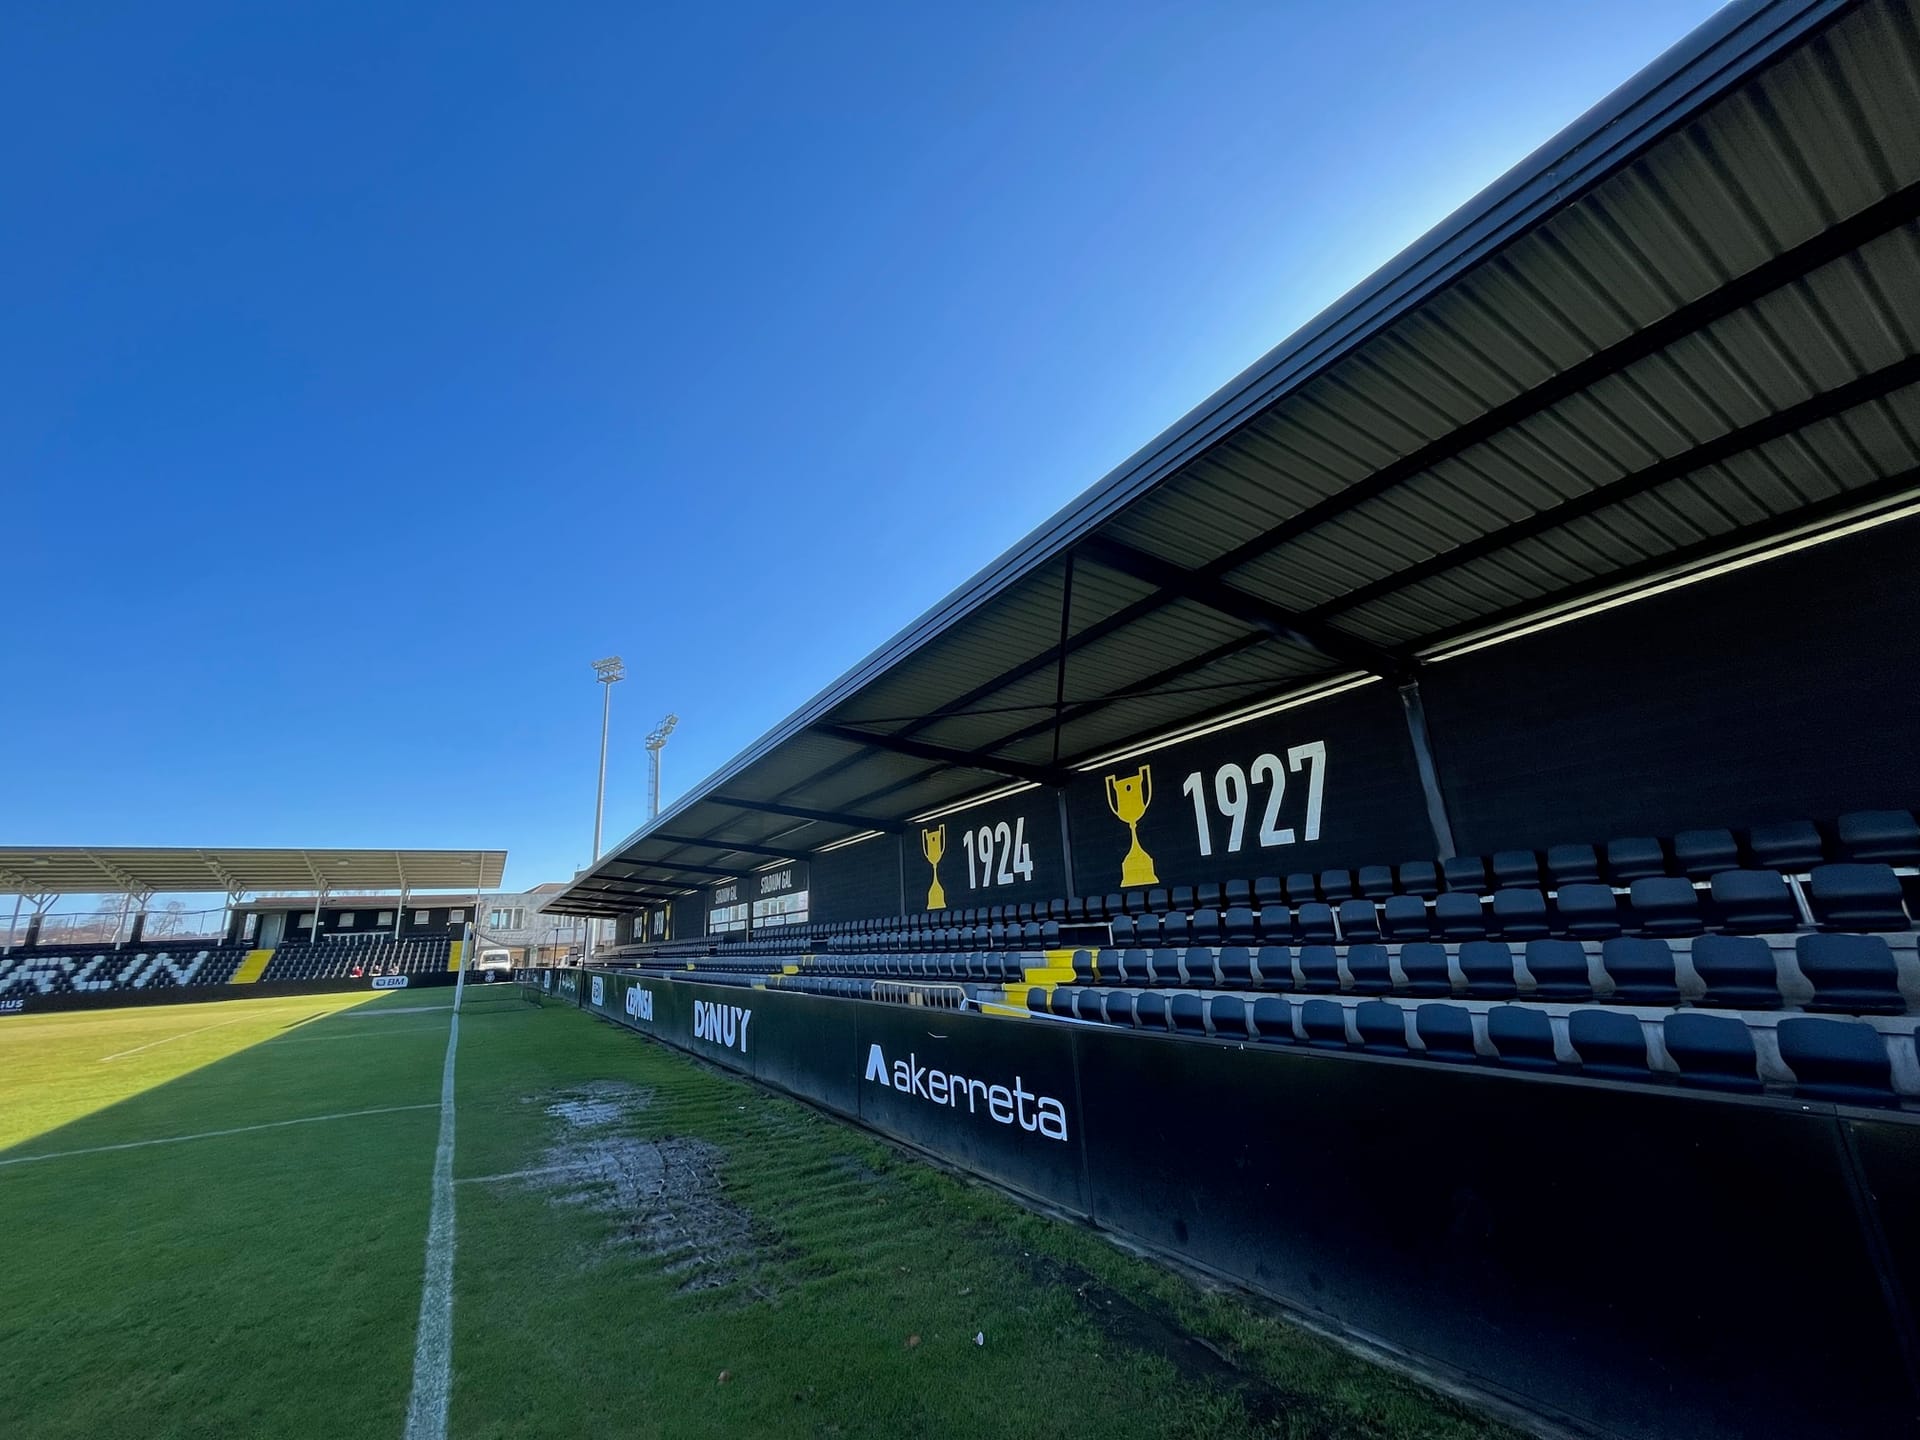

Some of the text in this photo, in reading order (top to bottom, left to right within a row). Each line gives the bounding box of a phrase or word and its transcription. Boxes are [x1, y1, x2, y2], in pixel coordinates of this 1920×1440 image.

[1183, 740, 1327, 856] 1927
[760, 871, 782, 894] STADIUM
[962, 816, 1034, 889] 1924
[893, 1053, 1068, 1142] akerreta
